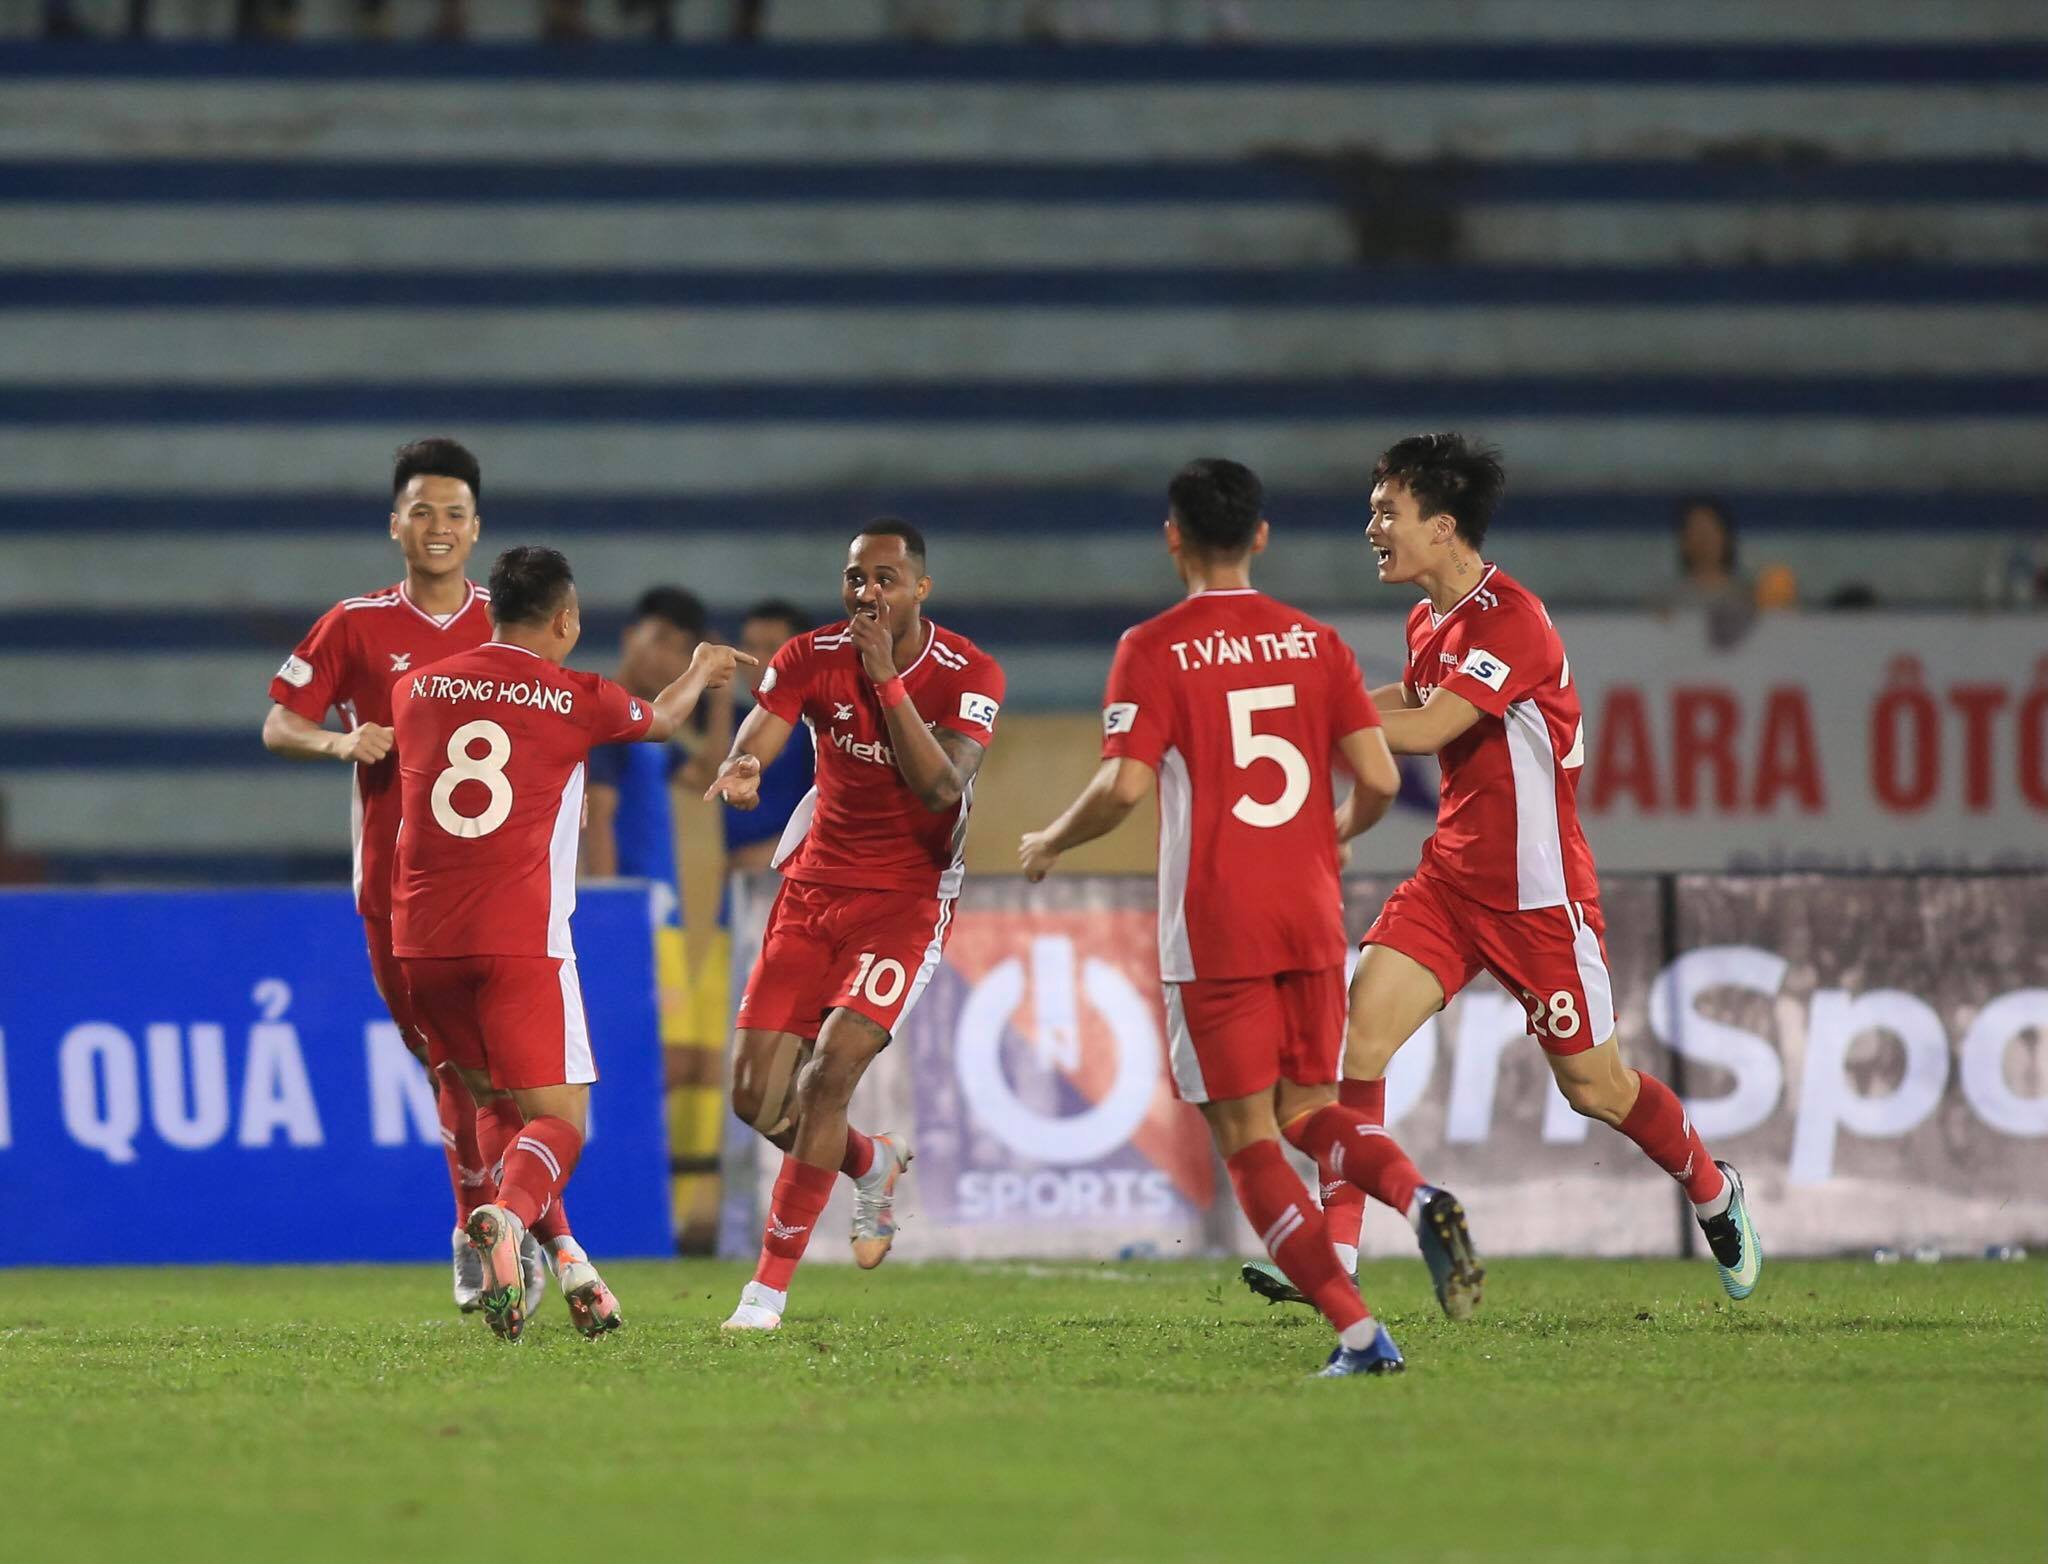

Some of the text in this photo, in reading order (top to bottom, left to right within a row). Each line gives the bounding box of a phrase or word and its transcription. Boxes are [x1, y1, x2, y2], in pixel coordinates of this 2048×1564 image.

[1171, 629, 1254, 671] T.VĂN
[496, 680, 573, 714] HOÀNG
[1227, 684, 1311, 828] 5
[1589, 680, 1828, 815] ARA
[431, 719, 513, 839] 8
[848, 951, 907, 1007] 10
[1522, 989, 1581, 1039] 28
[58, 976, 325, 1163] QUẢ
[956, 1169, 1178, 1218] SPORTS
